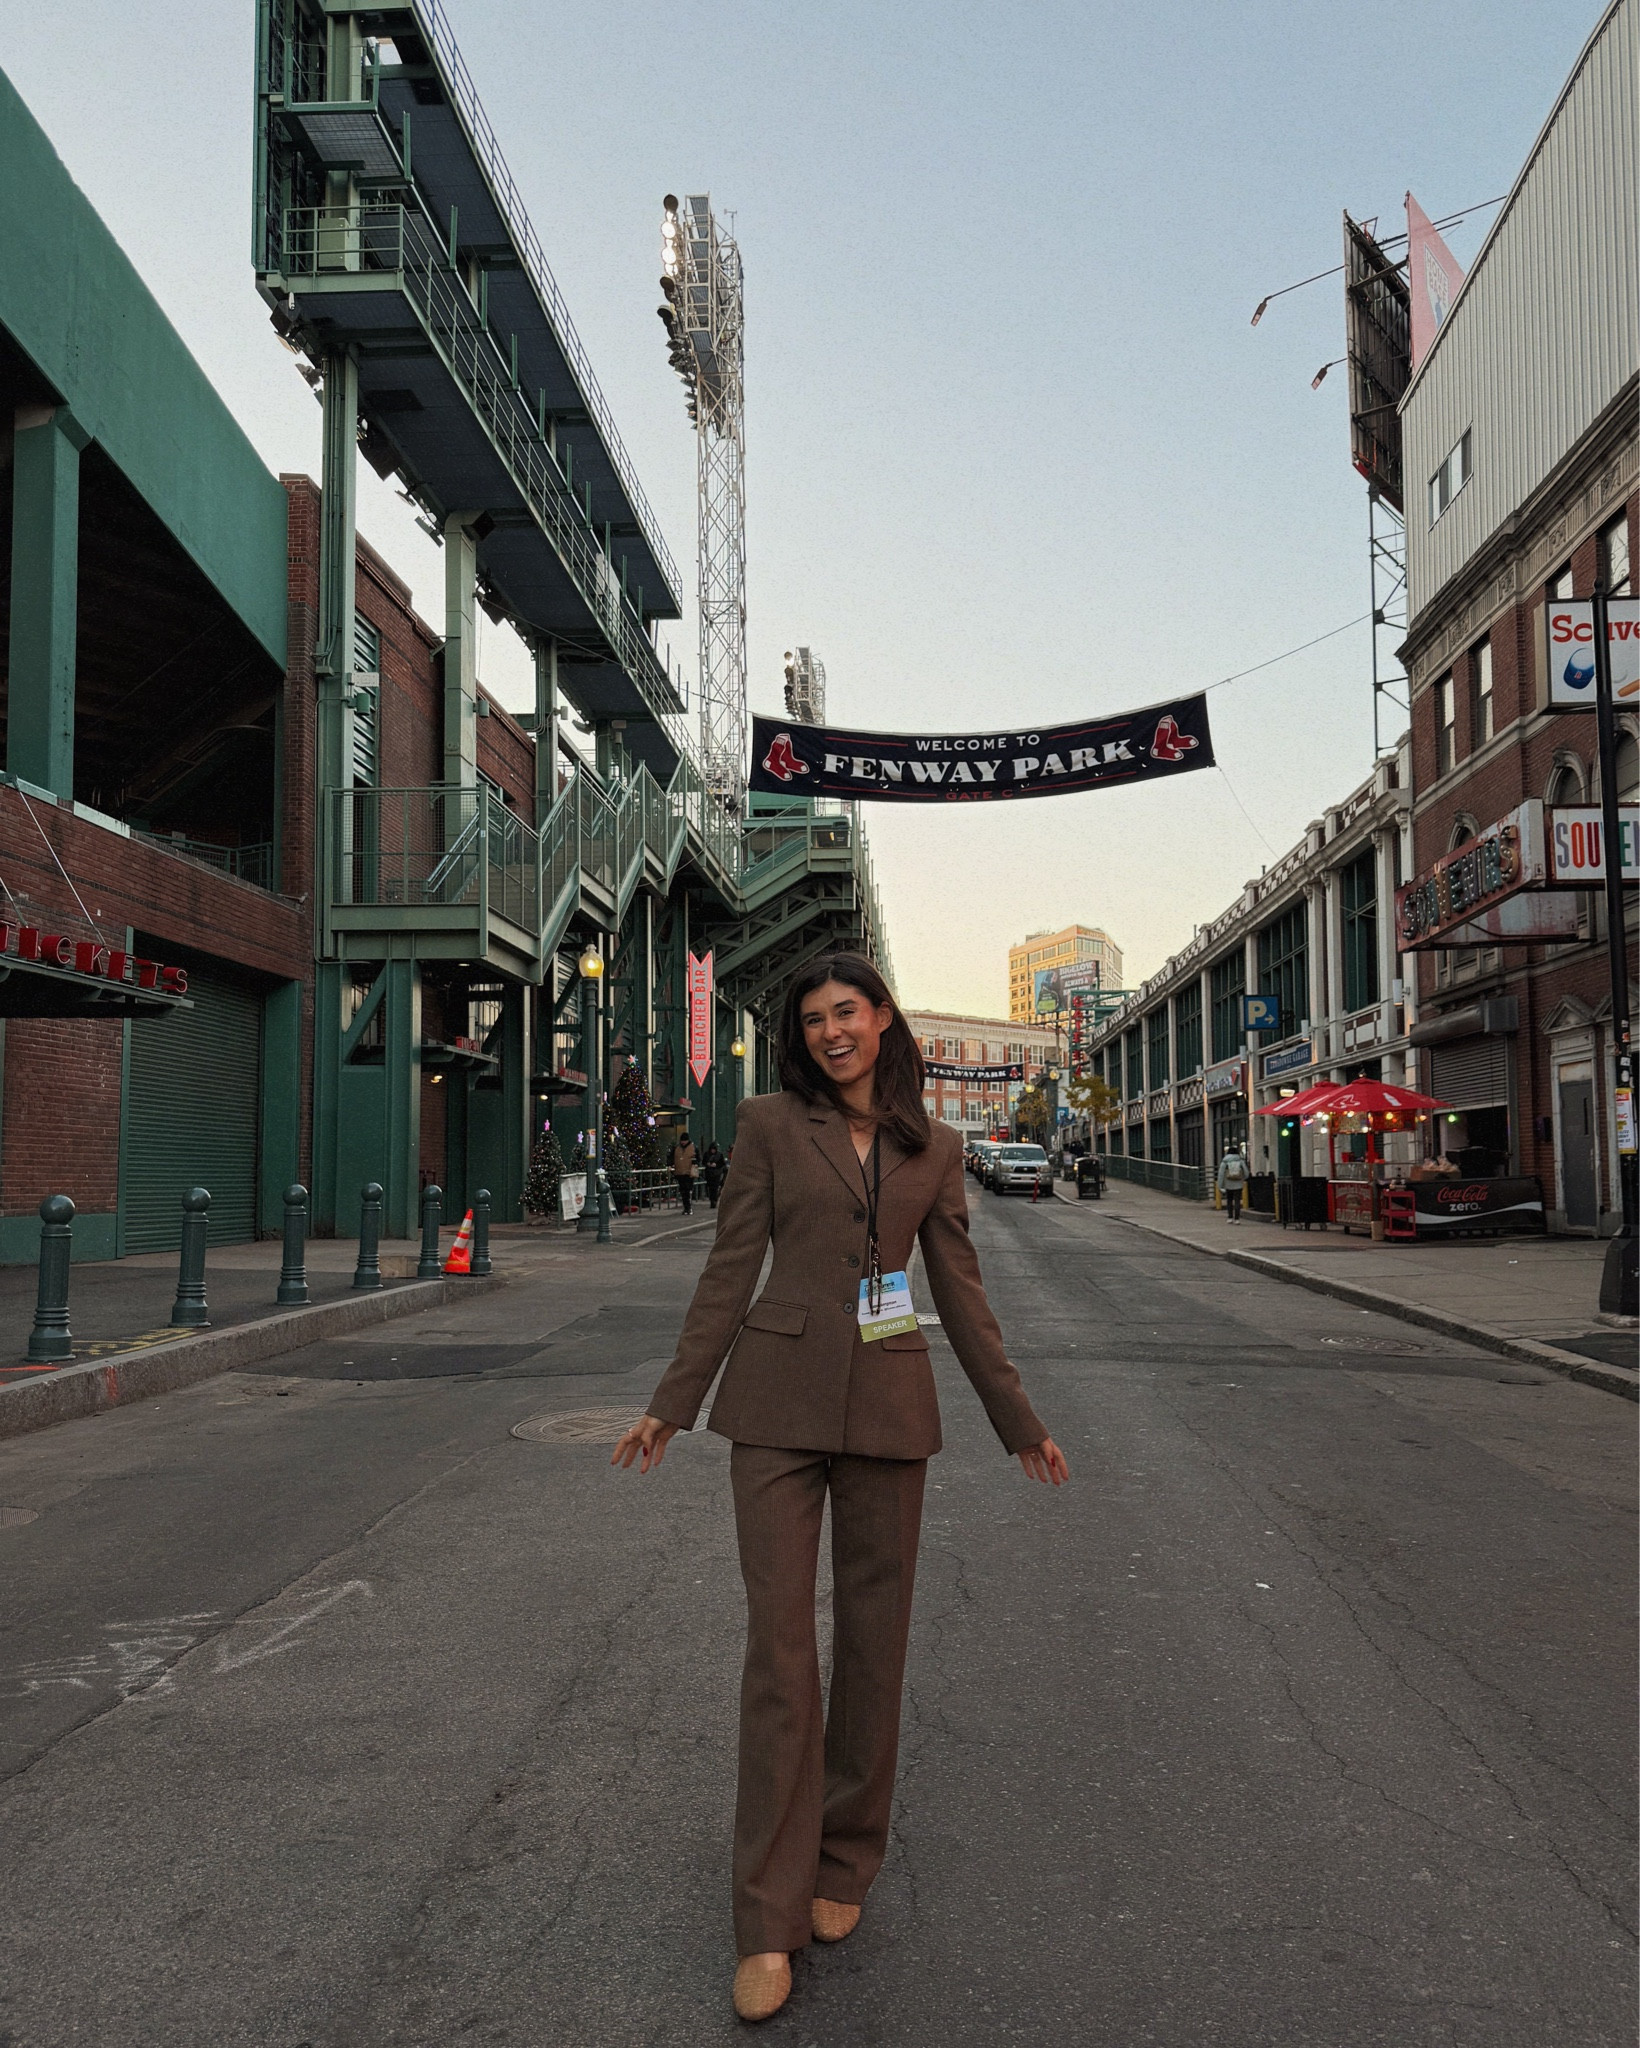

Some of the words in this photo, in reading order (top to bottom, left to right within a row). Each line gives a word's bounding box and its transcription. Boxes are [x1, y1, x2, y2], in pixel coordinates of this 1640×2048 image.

[916, 737, 1007, 751] WELCOME
[1016, 734, 1040, 747] TO
[823, 753, 1002, 783] FENWAY
[1012, 738, 1136, 780] PARK
[945, 790, 993, 800] GATE
[1001, 789, 1014, 798] C
[1555, 820, 1640, 869] SOUE
[1402, 825, 1520, 941] SOUVENIRS
[0, 920, 188, 993] TICKETS
[695, 969, 706, 992] BAR
[1247, 1000, 1267, 1025] P
[695, 998, 706, 1060] BLEACHER
[933, 1067, 976, 1078] FENWAY
[977, 1070, 1006, 1078] PARK
[873, 1320, 907, 1334] SPEAKER
